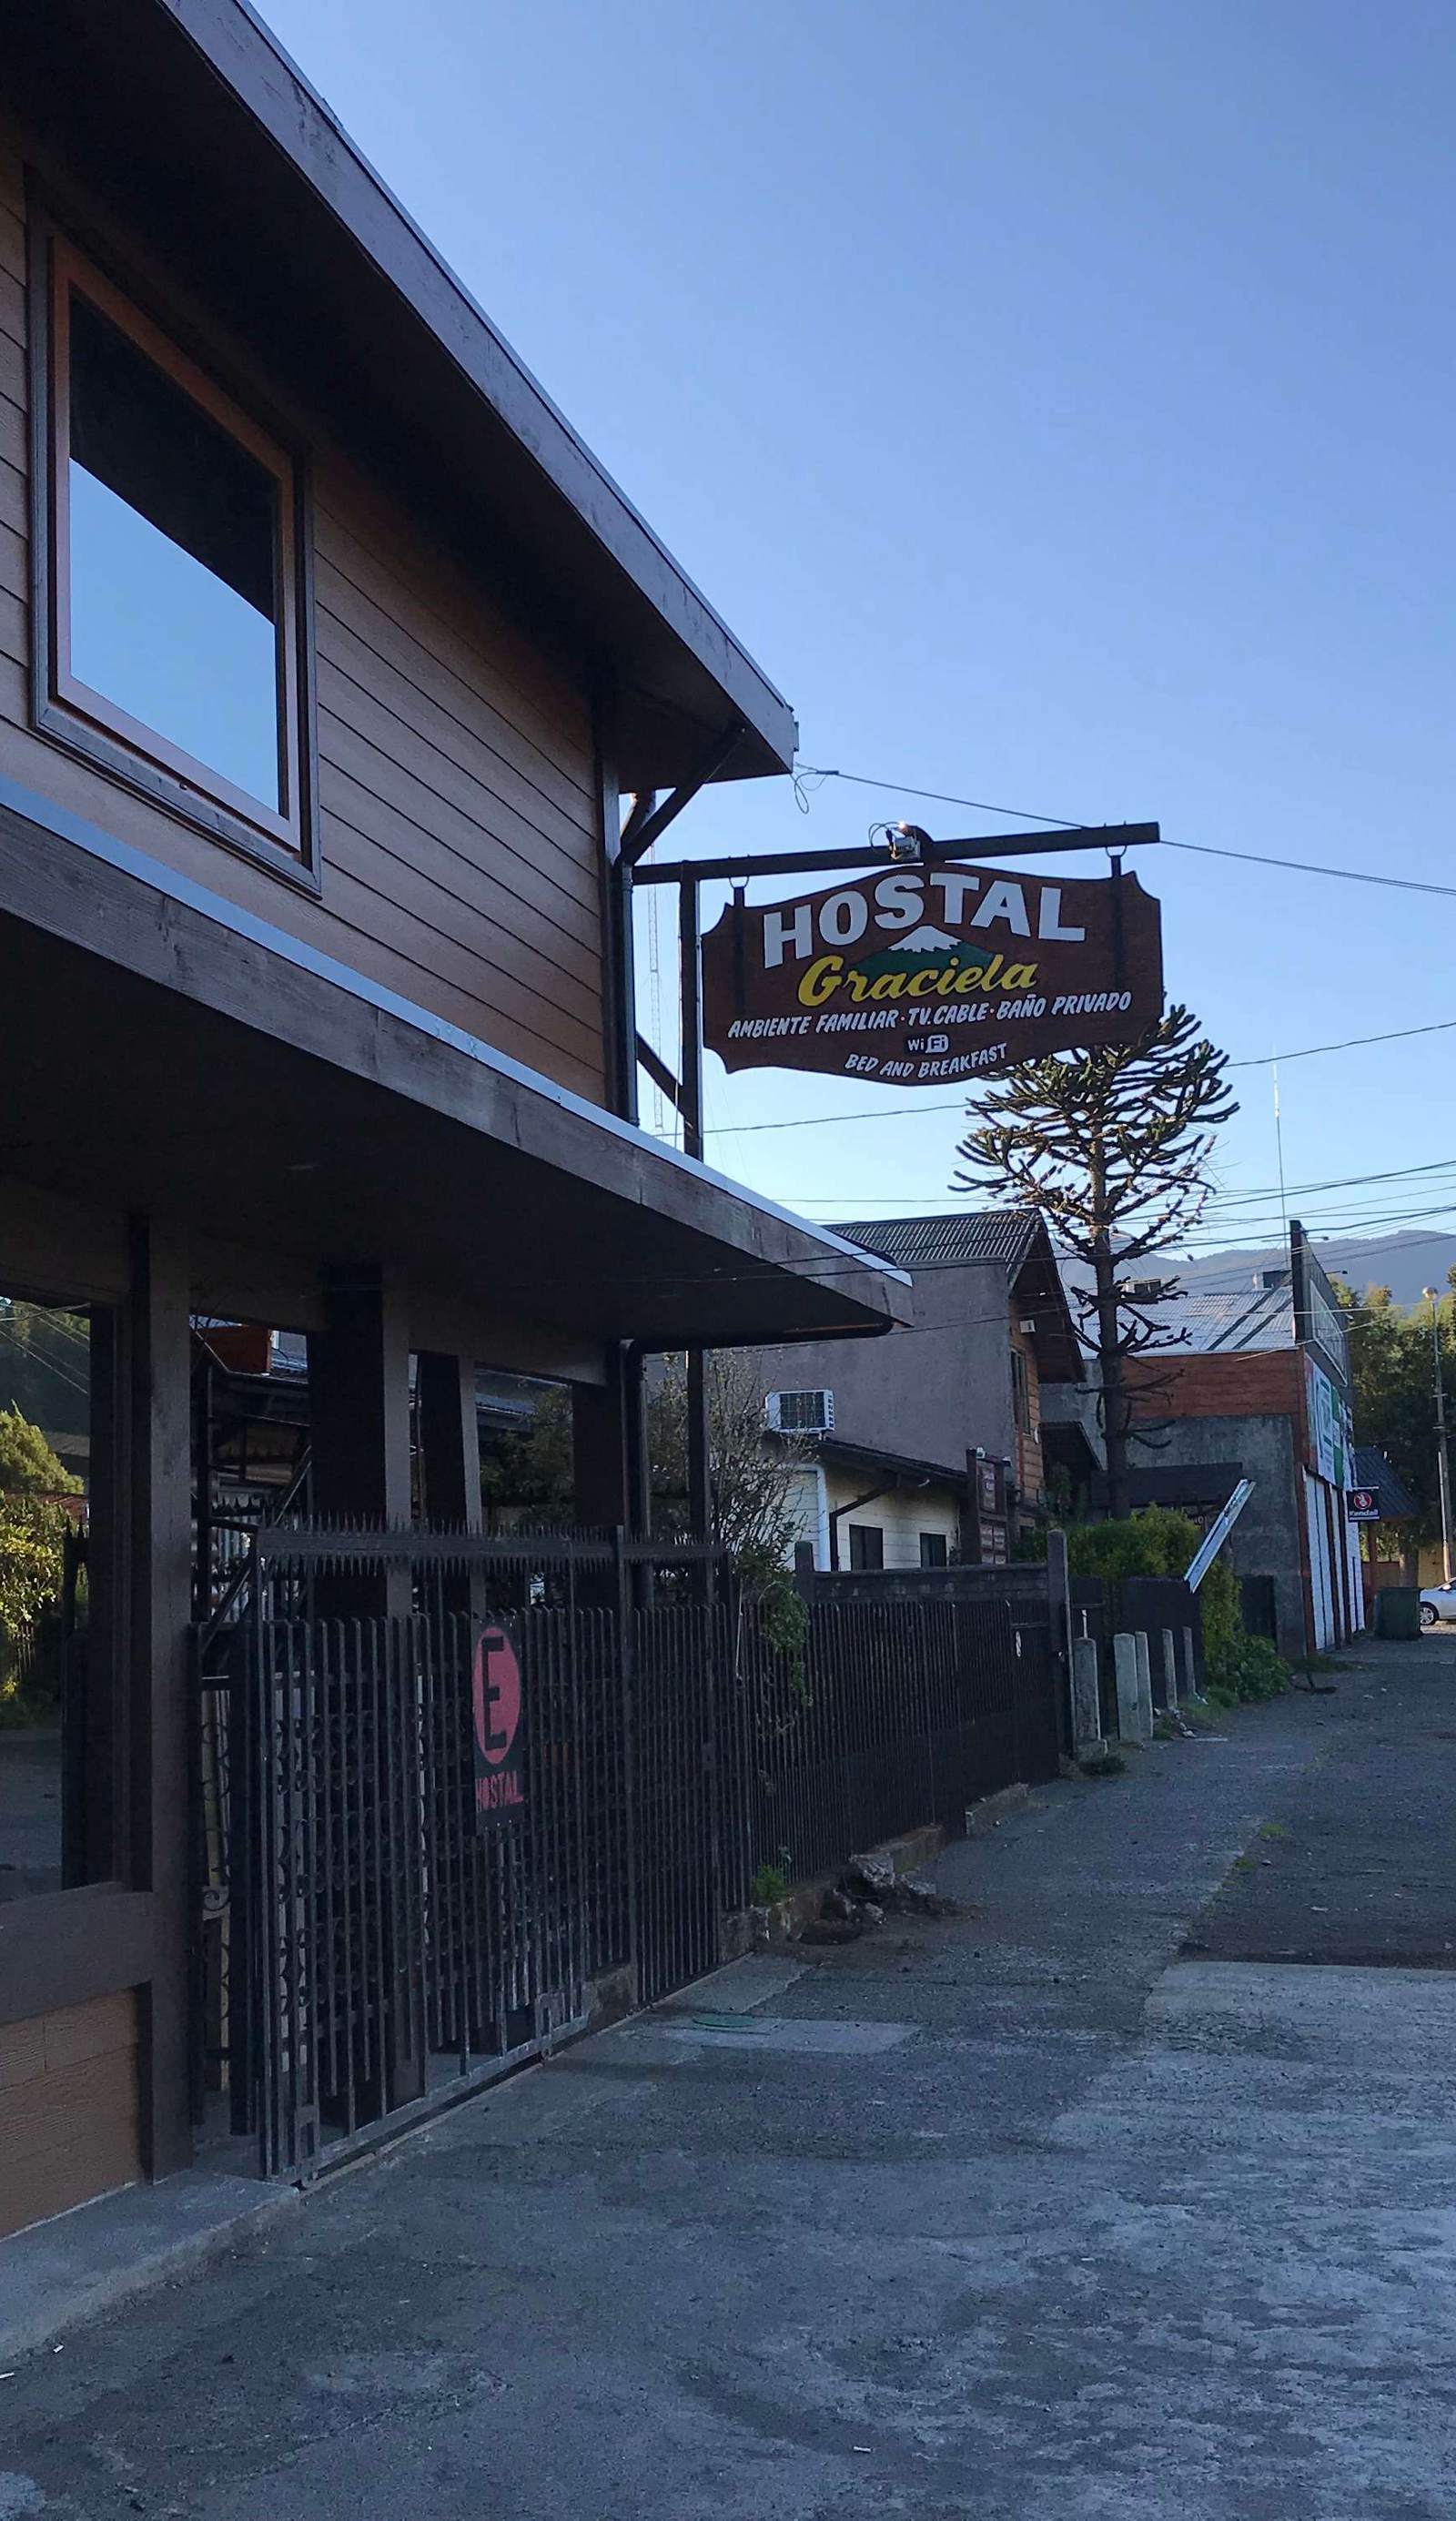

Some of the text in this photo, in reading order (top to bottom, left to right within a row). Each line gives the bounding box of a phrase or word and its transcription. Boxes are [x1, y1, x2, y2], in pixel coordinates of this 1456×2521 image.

[762, 872, 1086, 968] HOSTAL
[797, 953, 1039, 1007] Graciela
[727, 1014, 813, 1039] AMBIENTE
[815, 1008, 898, 1033] FAMILIAR
[996, 993, 1046, 1020] BAÑO
[1051, 991, 1132, 1015] PRIVADO
[844, 1042, 1007, 1078] BED AND BREAKFAST
[481, 1635, 507, 1751] E
